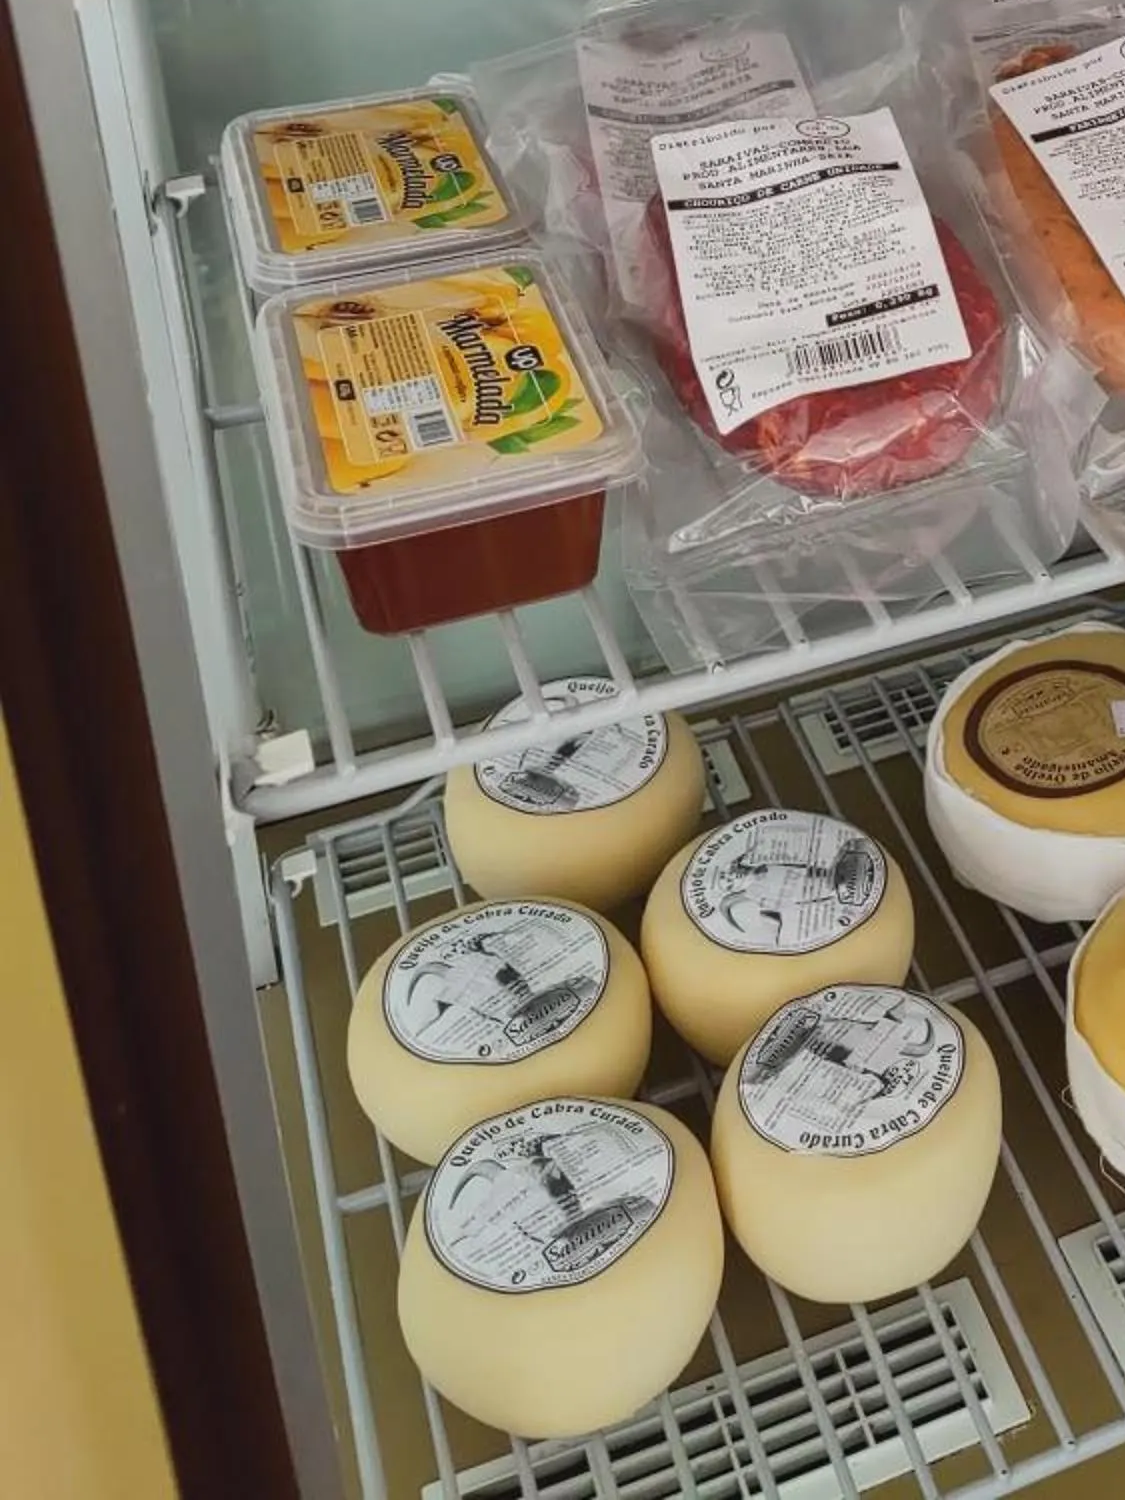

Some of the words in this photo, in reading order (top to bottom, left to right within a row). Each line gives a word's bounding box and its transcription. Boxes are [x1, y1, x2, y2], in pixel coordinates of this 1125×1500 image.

[375, 130, 435, 211] Marmelada
[437, 311, 516, 427] Marmelada
[566, 679, 616, 696] Queijo
[703, 832, 734, 866] Cabra
[732, 811, 789, 834] Curado
[398, 932, 441, 972] Queijo
[463, 907, 513, 925] Cabra
[518, 905, 572, 924] Curado
[450, 1124, 502, 1168] Queijo
[504, 1115, 526, 1131] de
[530, 1103, 584, 1120] Cabra
[588, 1106, 645, 1136] Curado
[799, 1130, 866, 1150] Curado
[869, 1111, 922, 1145] Cabra
